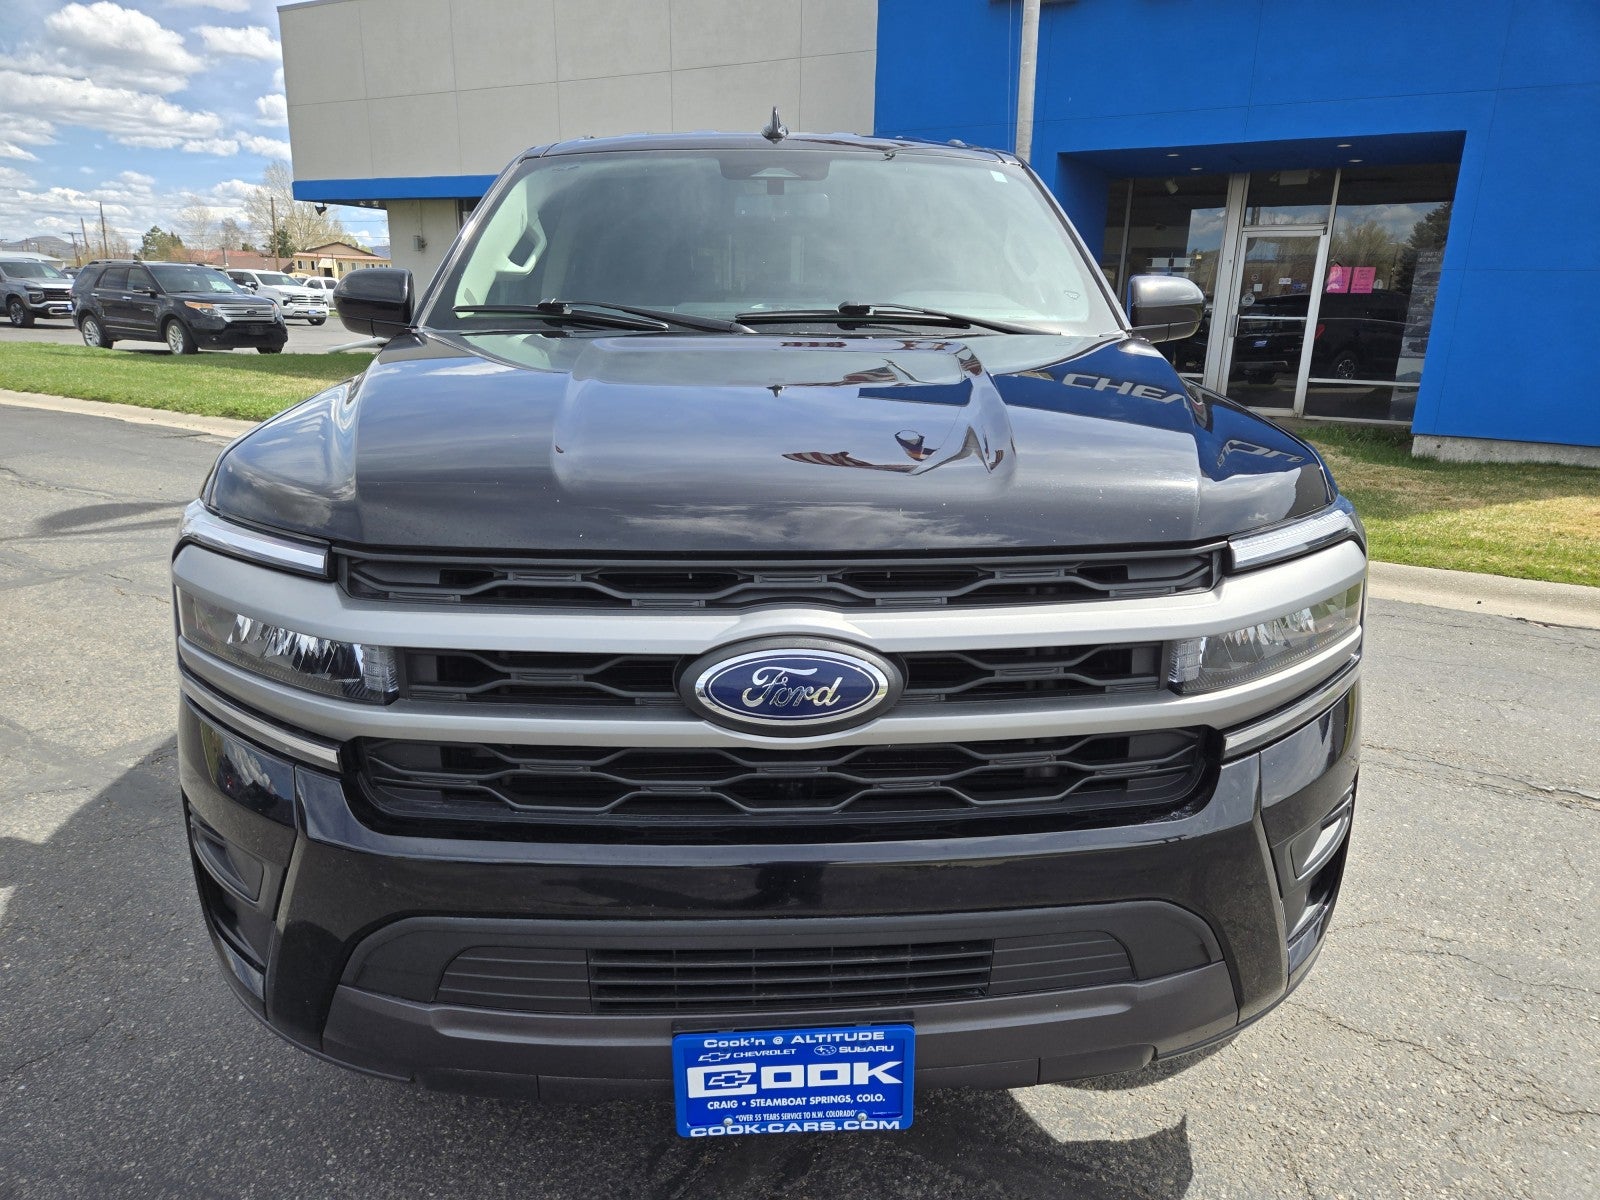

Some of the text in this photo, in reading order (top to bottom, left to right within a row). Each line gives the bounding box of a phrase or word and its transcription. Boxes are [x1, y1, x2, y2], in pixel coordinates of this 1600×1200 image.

[742, 666, 843, 707] Ford
[704, 1037, 766, 1048] Cook'n
[791, 1031, 885, 1044] ALTITUDE
[733, 1048, 797, 1058] CHEVROLET
[839, 1045, 895, 1053] SUBARU
[686, 1060, 903, 1098] COOK
[707, 1093, 886, 1110] CRAIG STEAMBOAT SPRINGS, COLO.
[755, 1113, 762, 1121] 55
[763, 1112, 780, 1121] YEARS
[781, 1111, 803, 1120] SERVICE
[803, 1111, 811, 1119] TO
[811, 1110, 825, 1119] N.W.
[690, 1120, 900, 1137] COOK-CARS.COM
